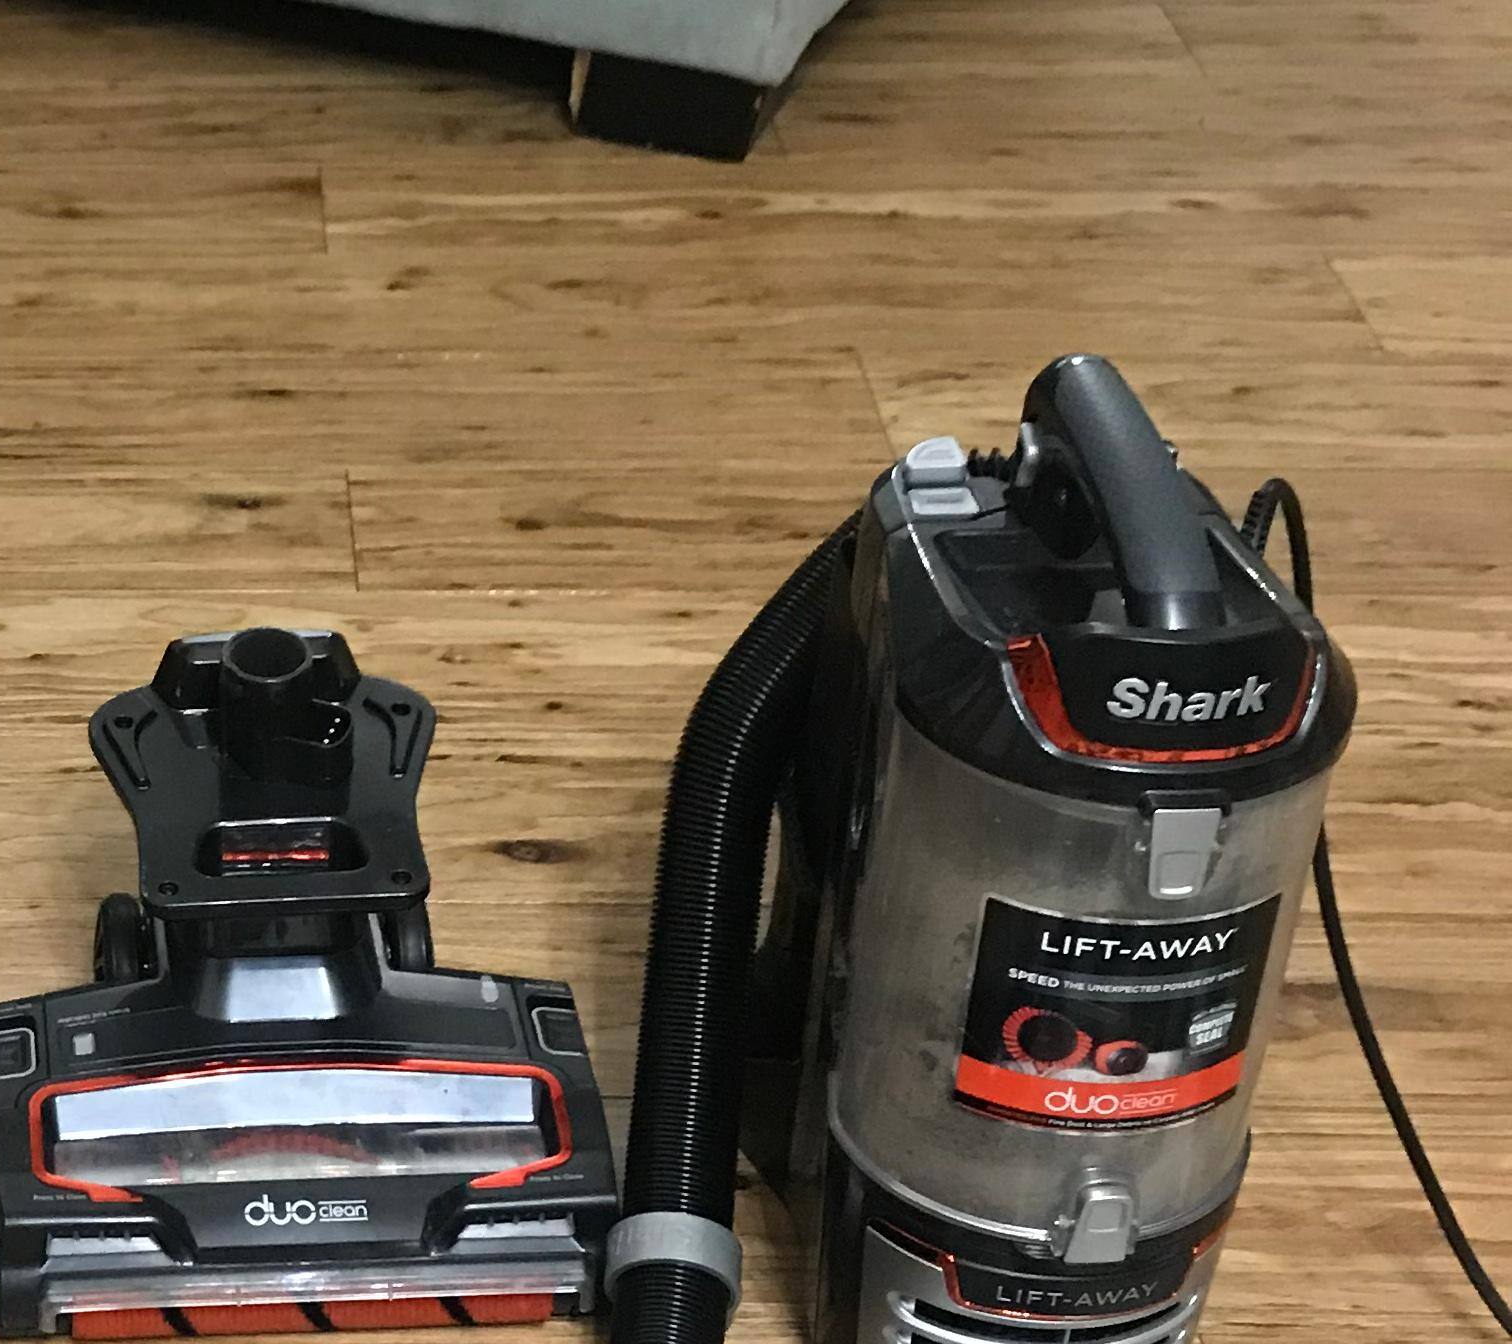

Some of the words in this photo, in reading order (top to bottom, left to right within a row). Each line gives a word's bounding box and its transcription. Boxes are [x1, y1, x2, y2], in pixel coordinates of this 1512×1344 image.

[1106, 675, 1272, 722] Shark
[1040, 928, 1238, 961] LIFT-AWAY
[1007, 967, 1060, 988] SPEED
[1063, 980, 1085, 991] THE
[1087, 983, 1161, 994] UNEXPECTED
[1162, 978, 1201, 991] POWER
[1202, 975, 1217, 986] OF
[1196, 1026, 1223, 1045] SEAL
[1044, 1087, 1120, 1116] duo
[1119, 1092, 1178, 1112] clean
[244, 1194, 317, 1226] duo
[318, 1203, 368, 1219] clean
[996, 1281, 1159, 1307] LIFT-AWAY
